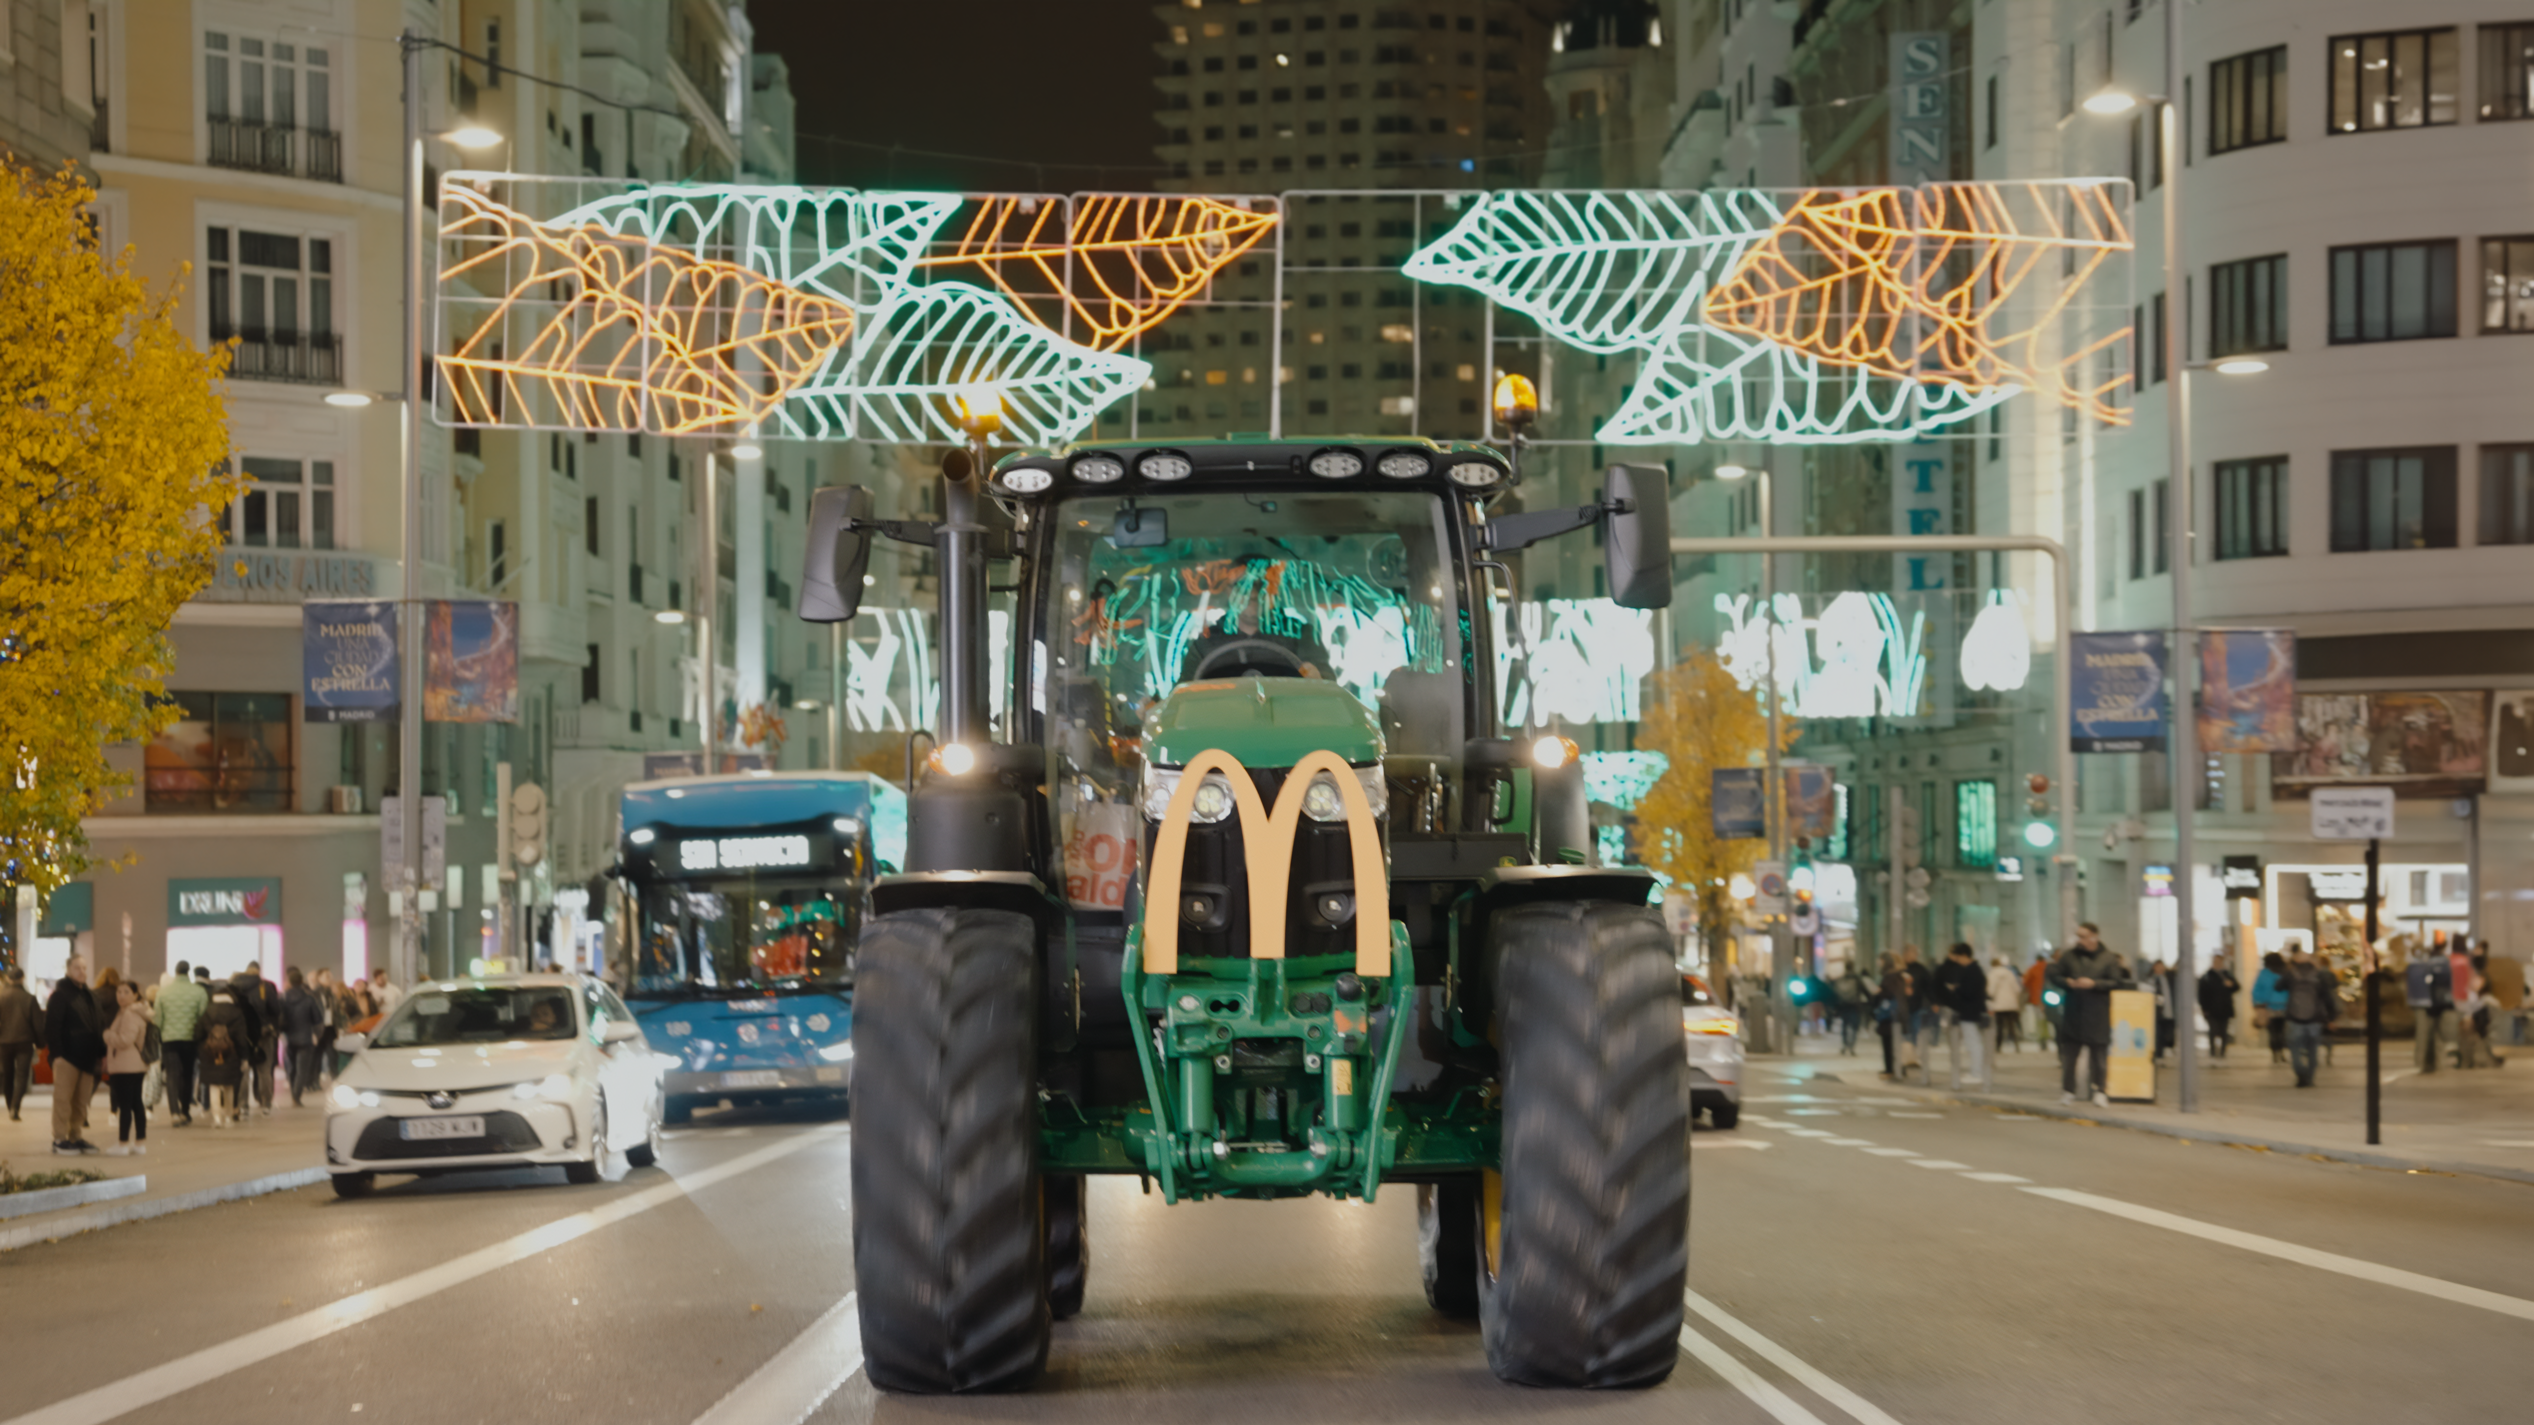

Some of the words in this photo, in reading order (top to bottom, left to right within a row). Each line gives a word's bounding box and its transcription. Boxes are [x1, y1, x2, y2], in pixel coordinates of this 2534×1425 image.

[301, 556, 375, 595] AIRES
[320, 622, 384, 637] MADRID
[332, 663, 368, 678] CON
[311, 677, 390, 692] ESTRELLA
